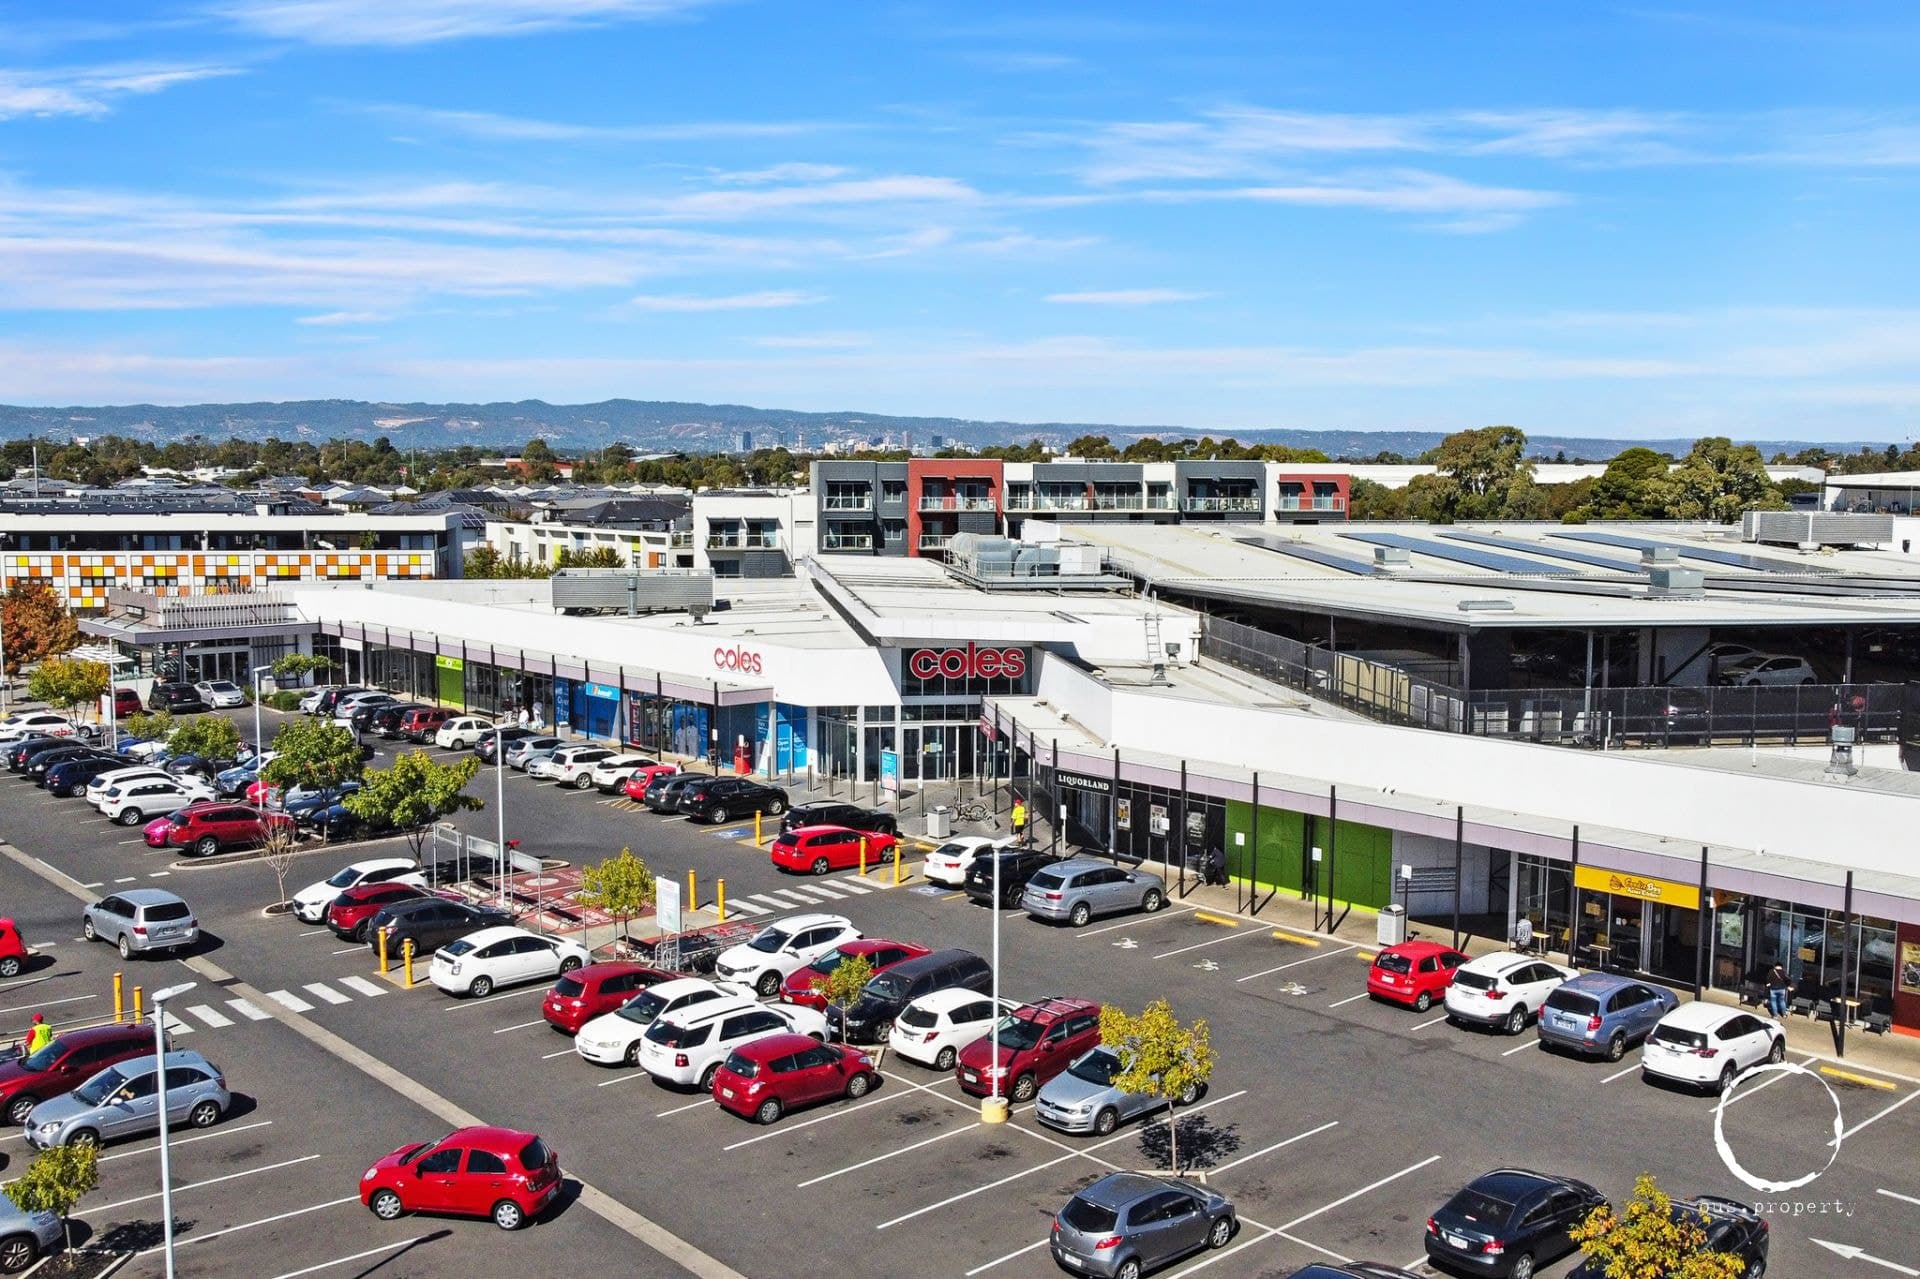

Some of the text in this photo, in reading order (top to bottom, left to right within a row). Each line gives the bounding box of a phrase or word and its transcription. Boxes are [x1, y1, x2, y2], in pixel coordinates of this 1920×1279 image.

[714, 645, 762, 673] coles
[910, 641, 1025, 679] coles
[1058, 774, 1110, 791] LIQUORLAND
